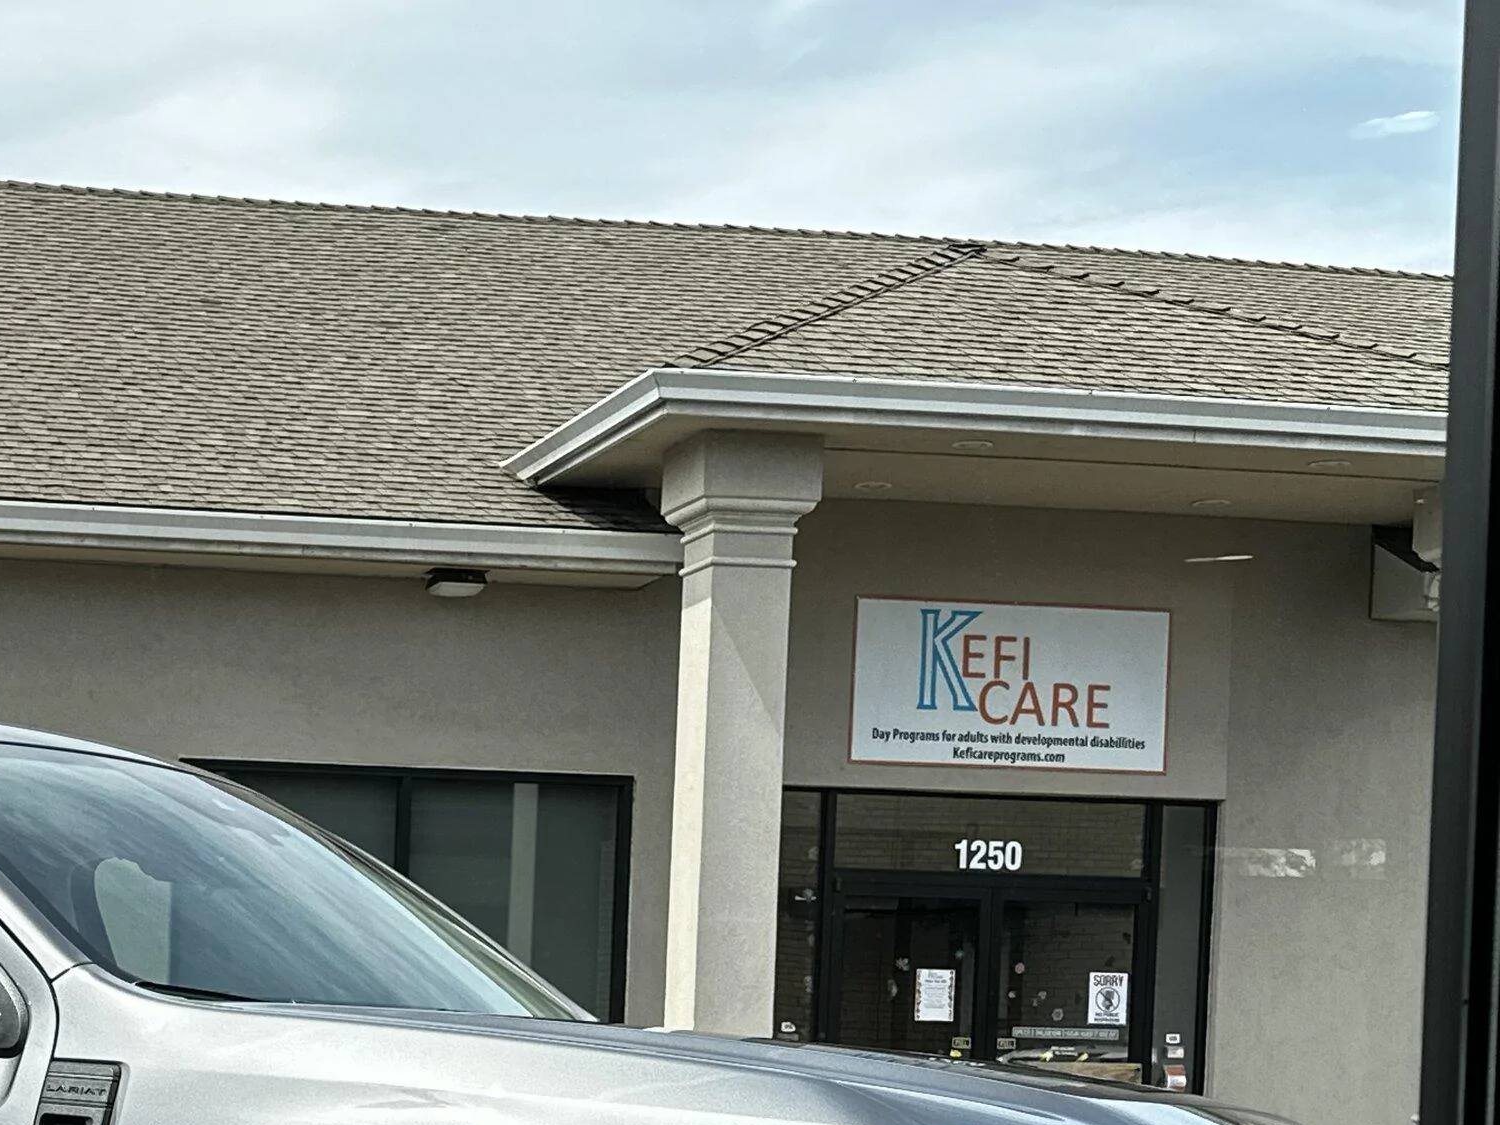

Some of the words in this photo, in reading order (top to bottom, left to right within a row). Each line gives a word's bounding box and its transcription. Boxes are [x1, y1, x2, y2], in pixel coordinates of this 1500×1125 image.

[916, 608, 1031, 712] KEFI
[978, 680, 1111, 728] CARE
[871, 727, 891, 743] Day
[892, 728, 940, 744] Programs
[941, 729, 957, 742] for
[957, 731, 989, 744] adults
[990, 732, 1013, 745] with
[1014, 732, 1088, 748] developmental
[1089, 736, 1146, 750] disabilities
[952, 746, 1066, 764] Keficareprograms.com
[954, 838, 1023, 871] 1250
[1093, 974, 1124, 987] SORRY
